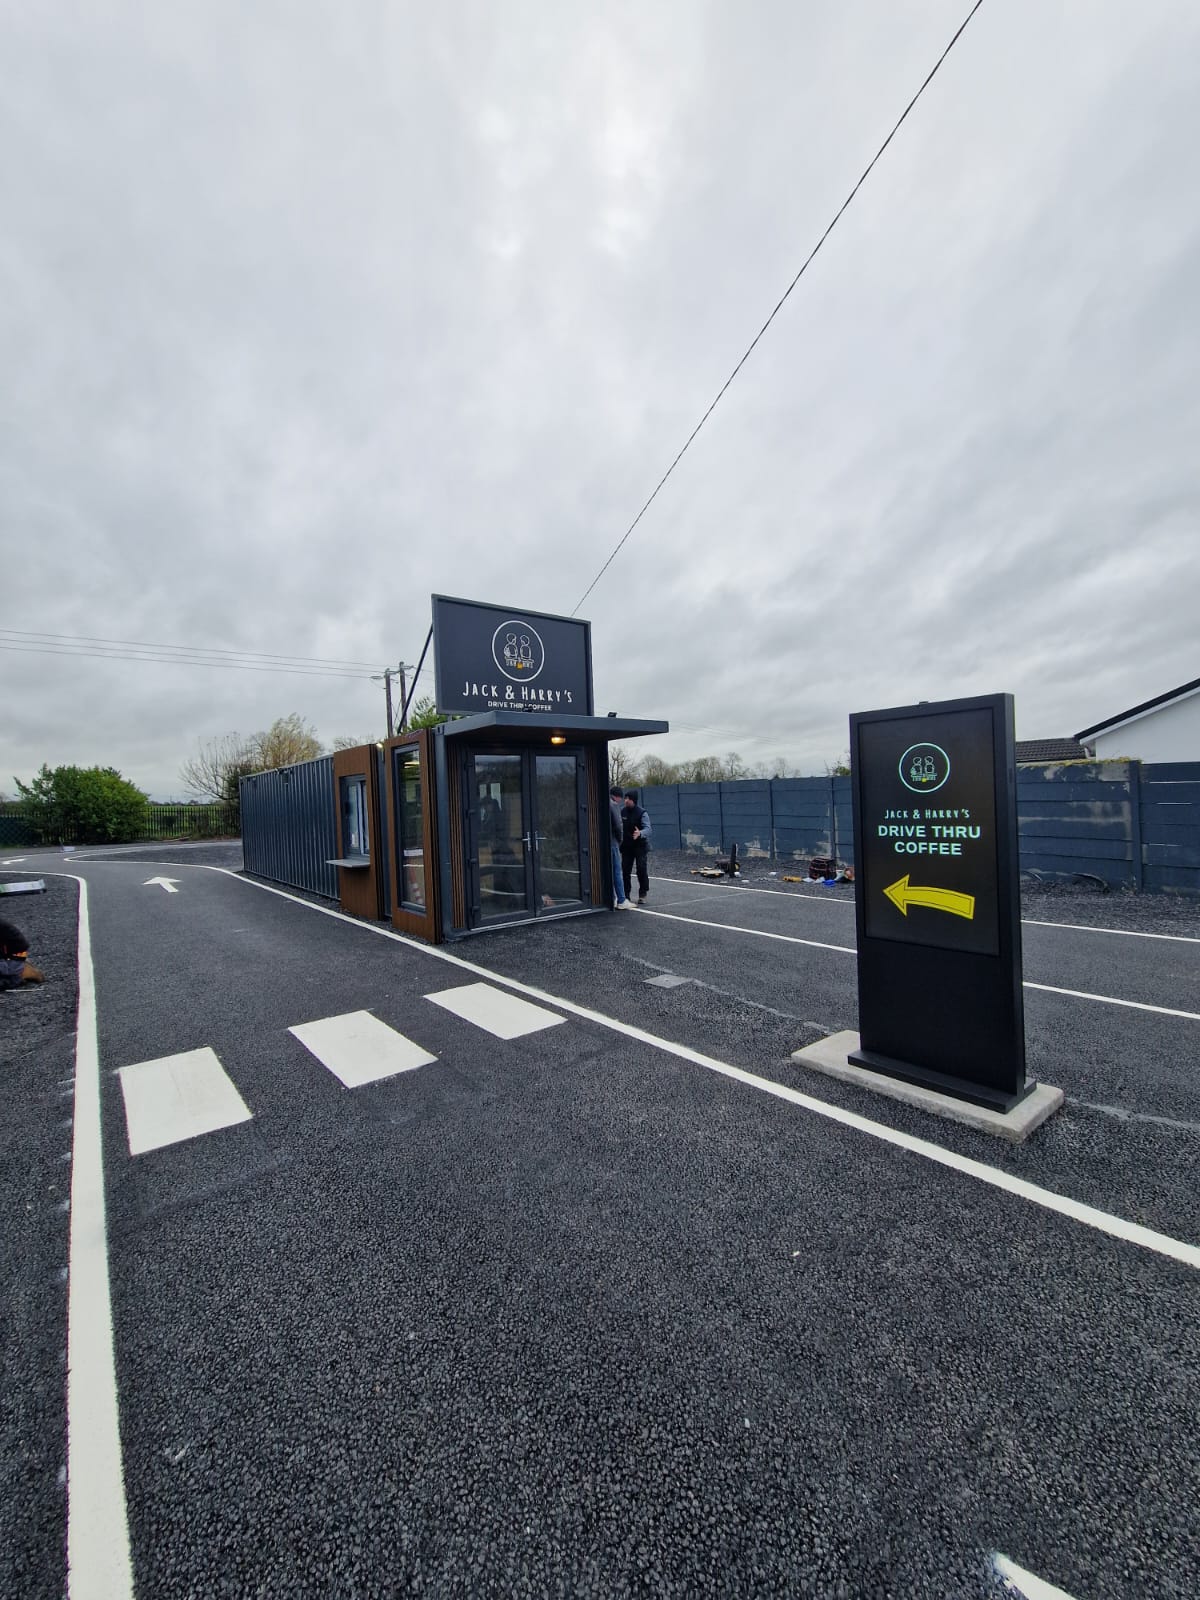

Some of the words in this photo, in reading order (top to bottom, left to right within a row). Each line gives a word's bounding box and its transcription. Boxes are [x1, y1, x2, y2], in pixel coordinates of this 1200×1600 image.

[463, 681, 498, 697] JACK
[505, 686, 515, 700] &
[522, 686, 573, 703] HARRY'S
[884, 809, 909, 819] JACK
[912, 809, 921, 819] &
[925, 808, 970, 819] HARRY'S
[878, 825, 925, 837] DRIVE
[932, 825, 981, 838] THRU
[895, 842, 961, 855] COFFEE
